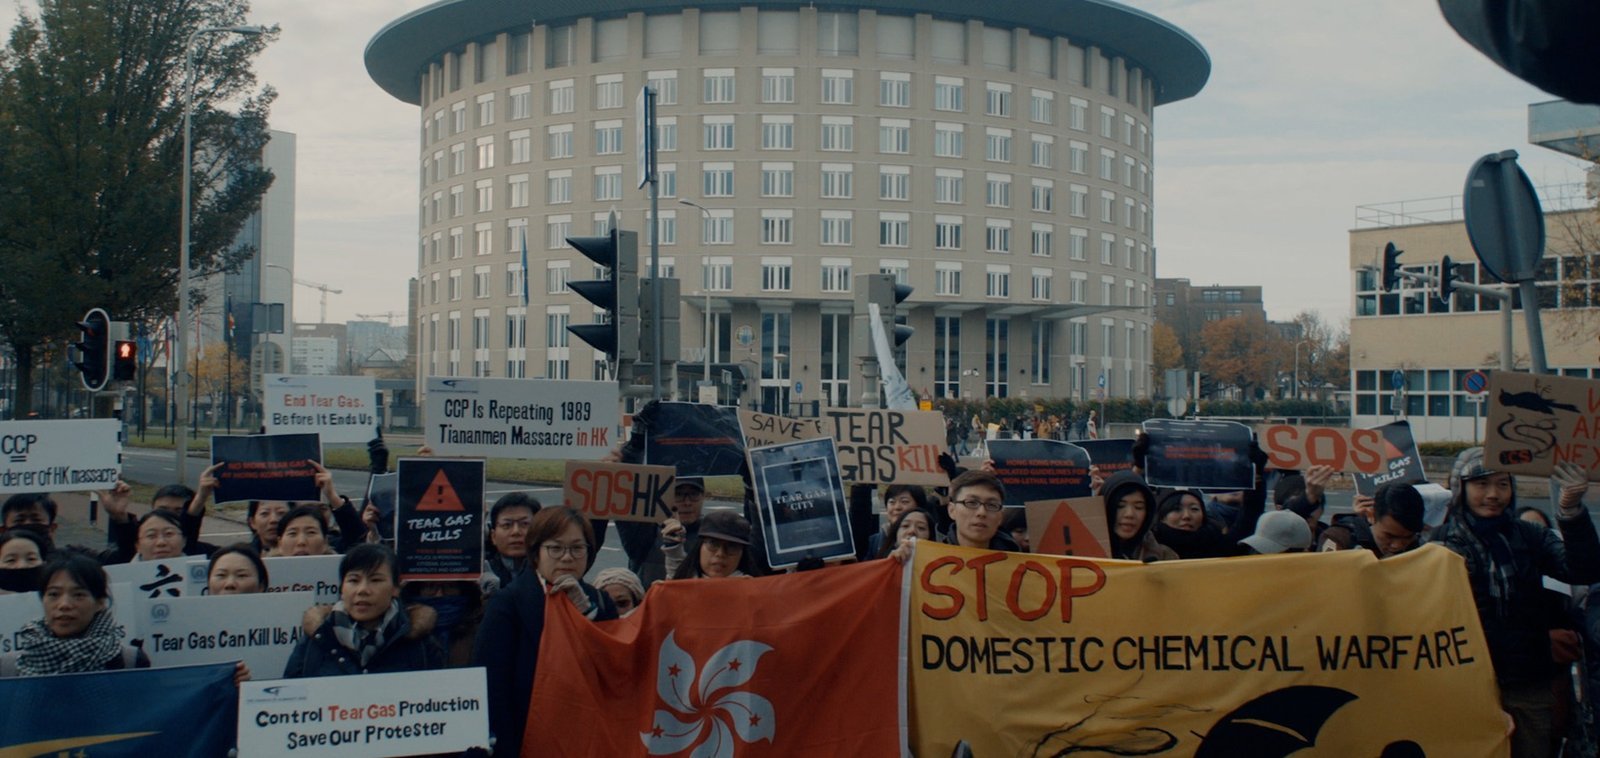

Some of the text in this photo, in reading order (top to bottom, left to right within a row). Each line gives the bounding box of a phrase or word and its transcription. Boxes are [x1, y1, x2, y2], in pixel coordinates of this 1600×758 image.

[284, 394, 306, 407] End
[310, 394, 334, 407] Tear
[273, 412, 374, 426] Before It Ends Us
[444, 399, 591, 426] CCP Is Repeating 1989
[439, 424, 609, 447] Tiananmen Massacre in HK
[749, 414, 805, 440] SAVE
[827, 411, 908, 445] TEAR
[2, 434, 38, 455] CCP
[1266, 425, 1381, 473] SOS
[838, 446, 896, 483] GAS
[1389, 456, 1411, 470] GAS
[54, 466, 71, 485] HK
[71, 468, 118, 485] massacre
[1374, 469, 1405, 486] KILLS
[775, 488, 827, 505] TEAR GAS
[790, 500, 815, 512] CITY
[407, 514, 474, 531] TEAR GAS
[420, 529, 463, 544] KILLS
[920, 552, 1107, 623] STOP
[152, 633, 185, 652] Tear
[188, 631, 216, 650] Gas
[218, 630, 247, 648] Can
[249, 627, 271, 646] Kill
[273, 628, 288, 645] Us
[921, 626, 1475, 674] DOMESTIC CHEMICAL WARFARE
[256, 696, 480, 728] Control Tear Gas Production
[287, 720, 447, 751] Save Our Protester
